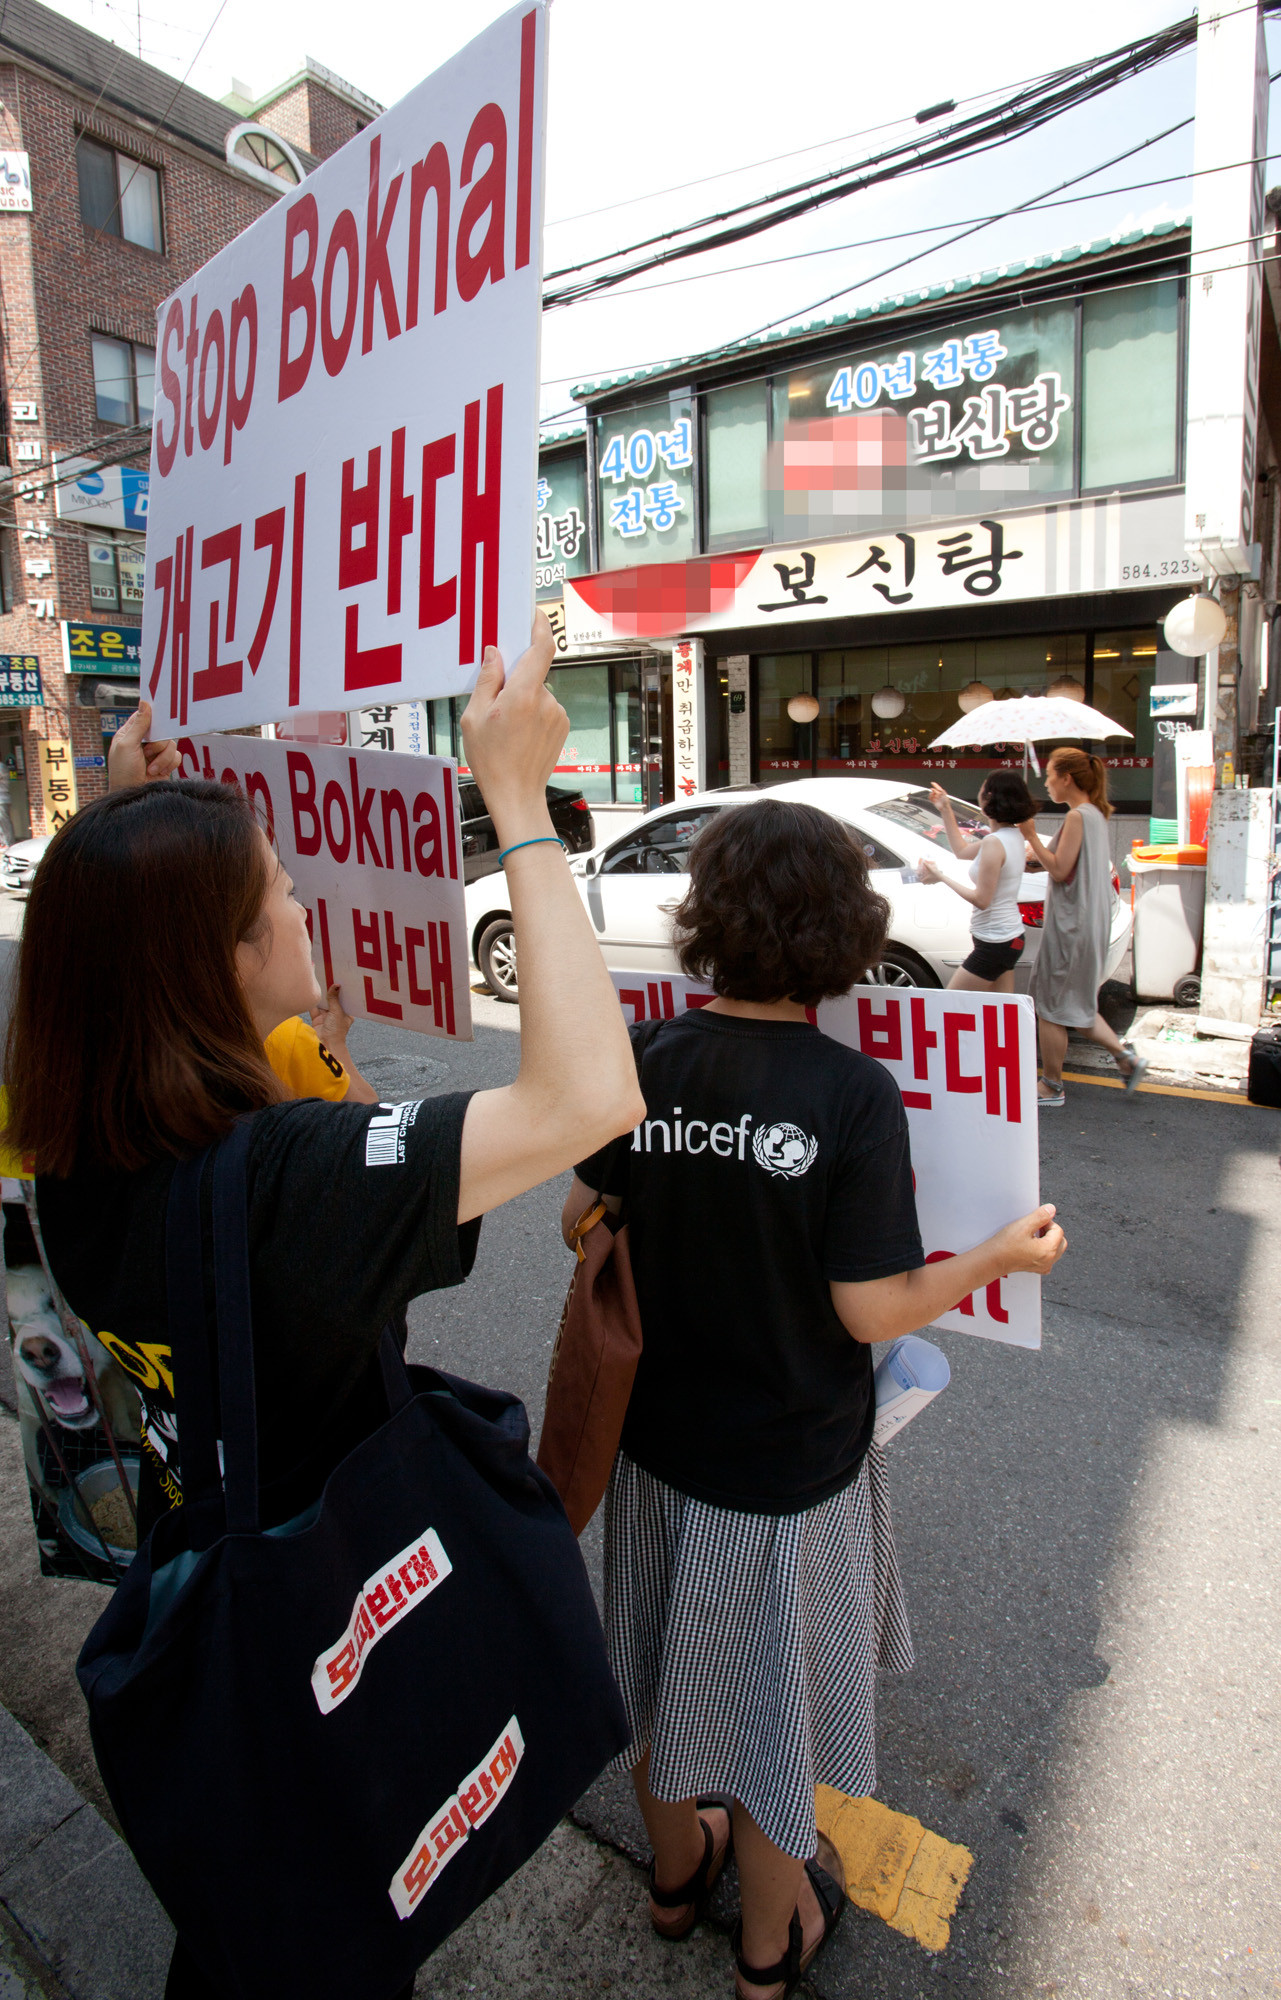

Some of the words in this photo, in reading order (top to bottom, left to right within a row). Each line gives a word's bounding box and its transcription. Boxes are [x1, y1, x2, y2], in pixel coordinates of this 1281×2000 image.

[157, 283, 257, 477] Stop
[278, 8, 536, 404] Boknal
[828, 354, 915, 411] 40년
[923, 331, 1007, 389] 전통
[601, 420, 692, 482] 40년
[911, 375, 1069, 461] 보신탕
[611, 483, 683, 536] 전통
[149, 473, 306, 726] 개고기
[338, 384, 503, 692] 반대
[758, 521, 1023, 612] 보신탕
[9, 657, 38, 671] 조은
[70, 629, 125, 658] 조은
[677, 701, 694, 770] 취급하는
[733, 694, 742, 702] 69
[286, 751, 458, 880] Boknal
[352, 909, 456, 1035] 반대
[857, 997, 1021, 1123] 반대
[398, 1139, 406, 1163] LAST
[326, 1545, 438, 1699] 모피반대
[402, 1734, 518, 1906] 모피반대
